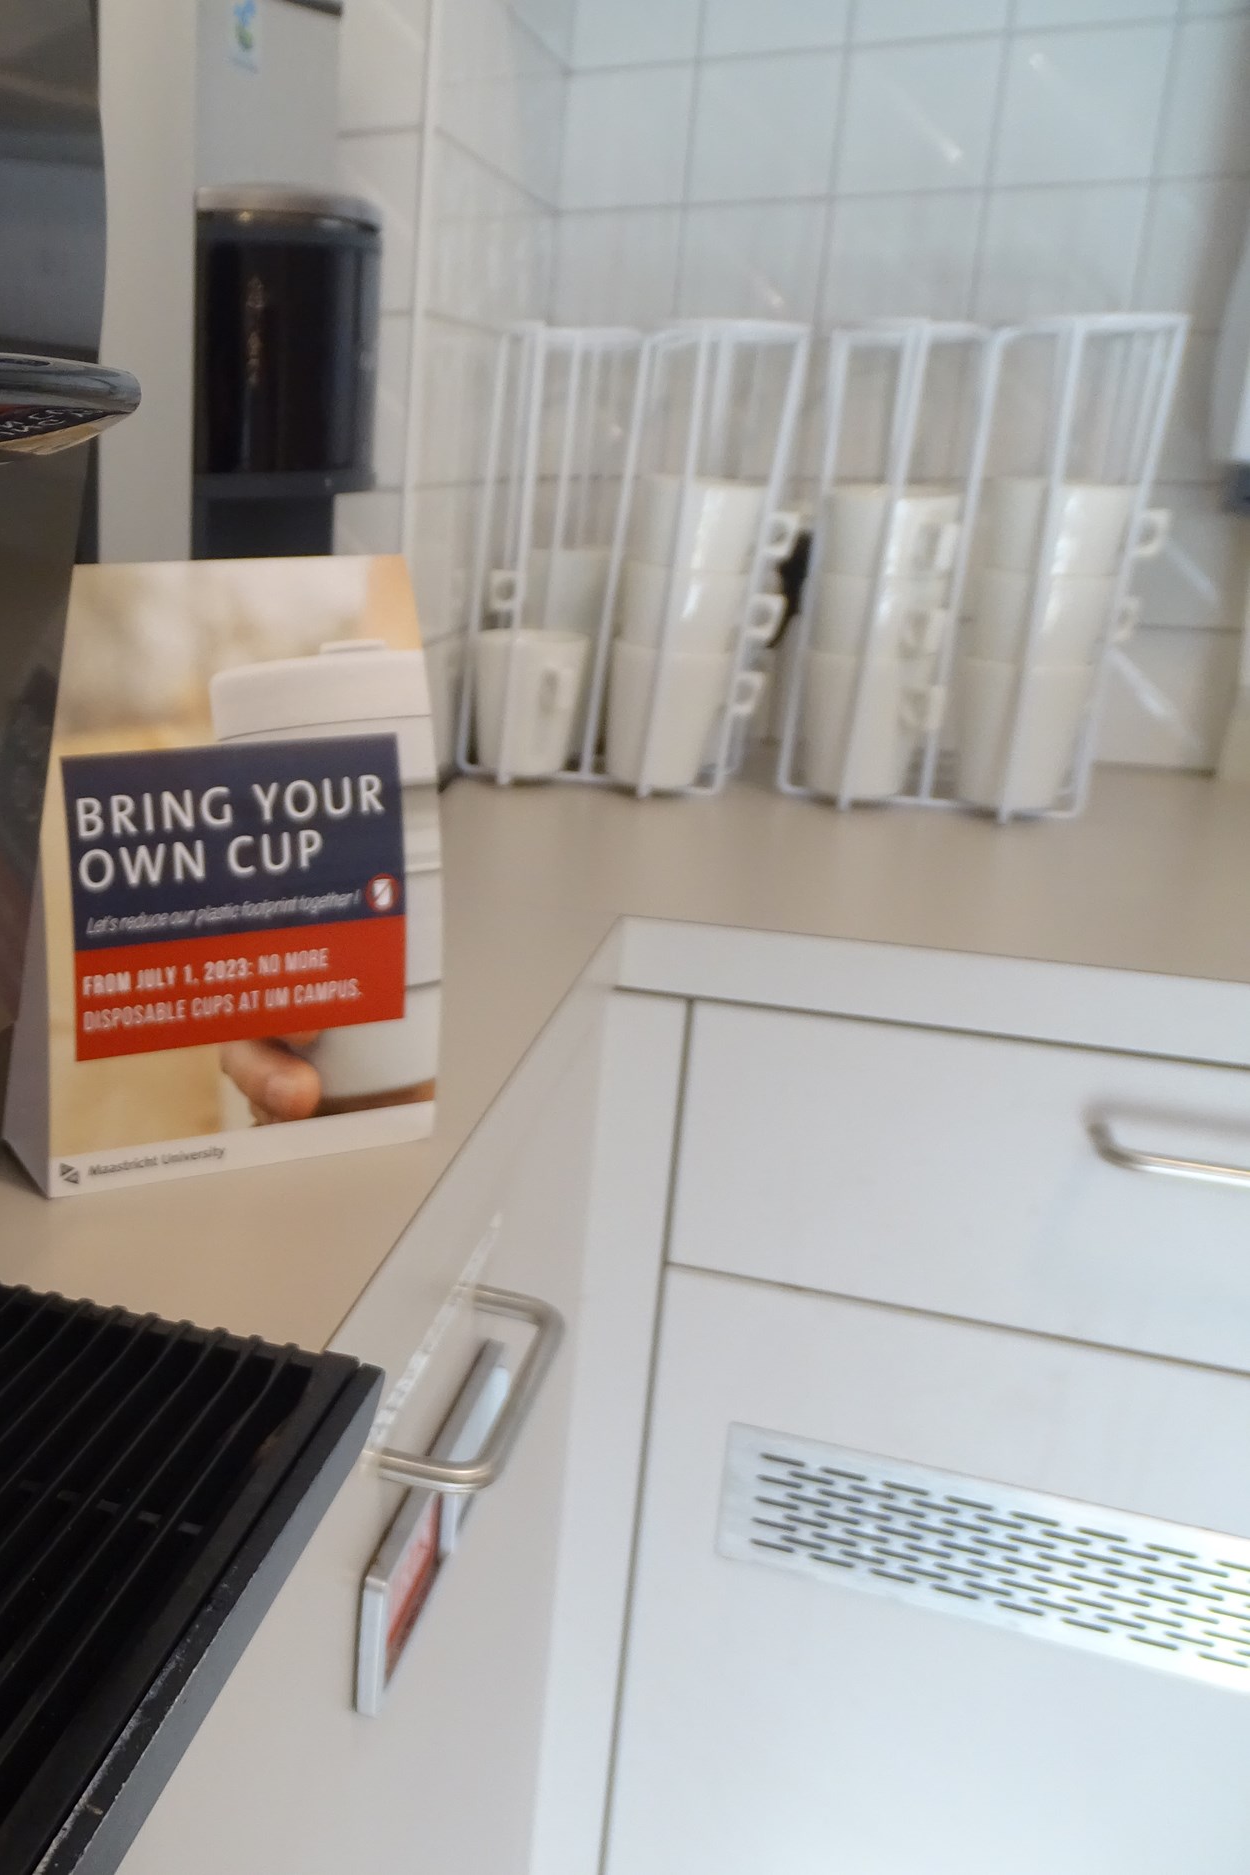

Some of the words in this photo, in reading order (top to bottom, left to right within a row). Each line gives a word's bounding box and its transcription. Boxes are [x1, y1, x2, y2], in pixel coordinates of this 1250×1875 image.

[76, 786, 233, 840] BRING
[252, 774, 385, 824] YOUR
[79, 840, 205, 892] OWN
[227, 829, 323, 877] CUP
[86, 916, 120, 935] Let's
[120, 911, 168, 931] reduce
[170, 910, 195, 926] our
[195, 903, 239, 926] plastic
[240, 897, 298, 921] footprint
[82, 971, 131, 996] FROM
[136, 965, 177, 990] JULY
[203, 957, 254, 982] 2023:
[258, 953, 280, 975] NO
[285, 948, 329, 972] MORE
[83, 998, 186, 1031] DISPOSABLE
[191, 992, 234, 1018] CUPS
[238, 990, 260, 1011] AT
[265, 985, 290, 1008] UM
[294, 978, 363, 1005] CAMPUS.
[88, 1156, 158, 1176] Maastricht
[161, 1145, 226, 1165] University
